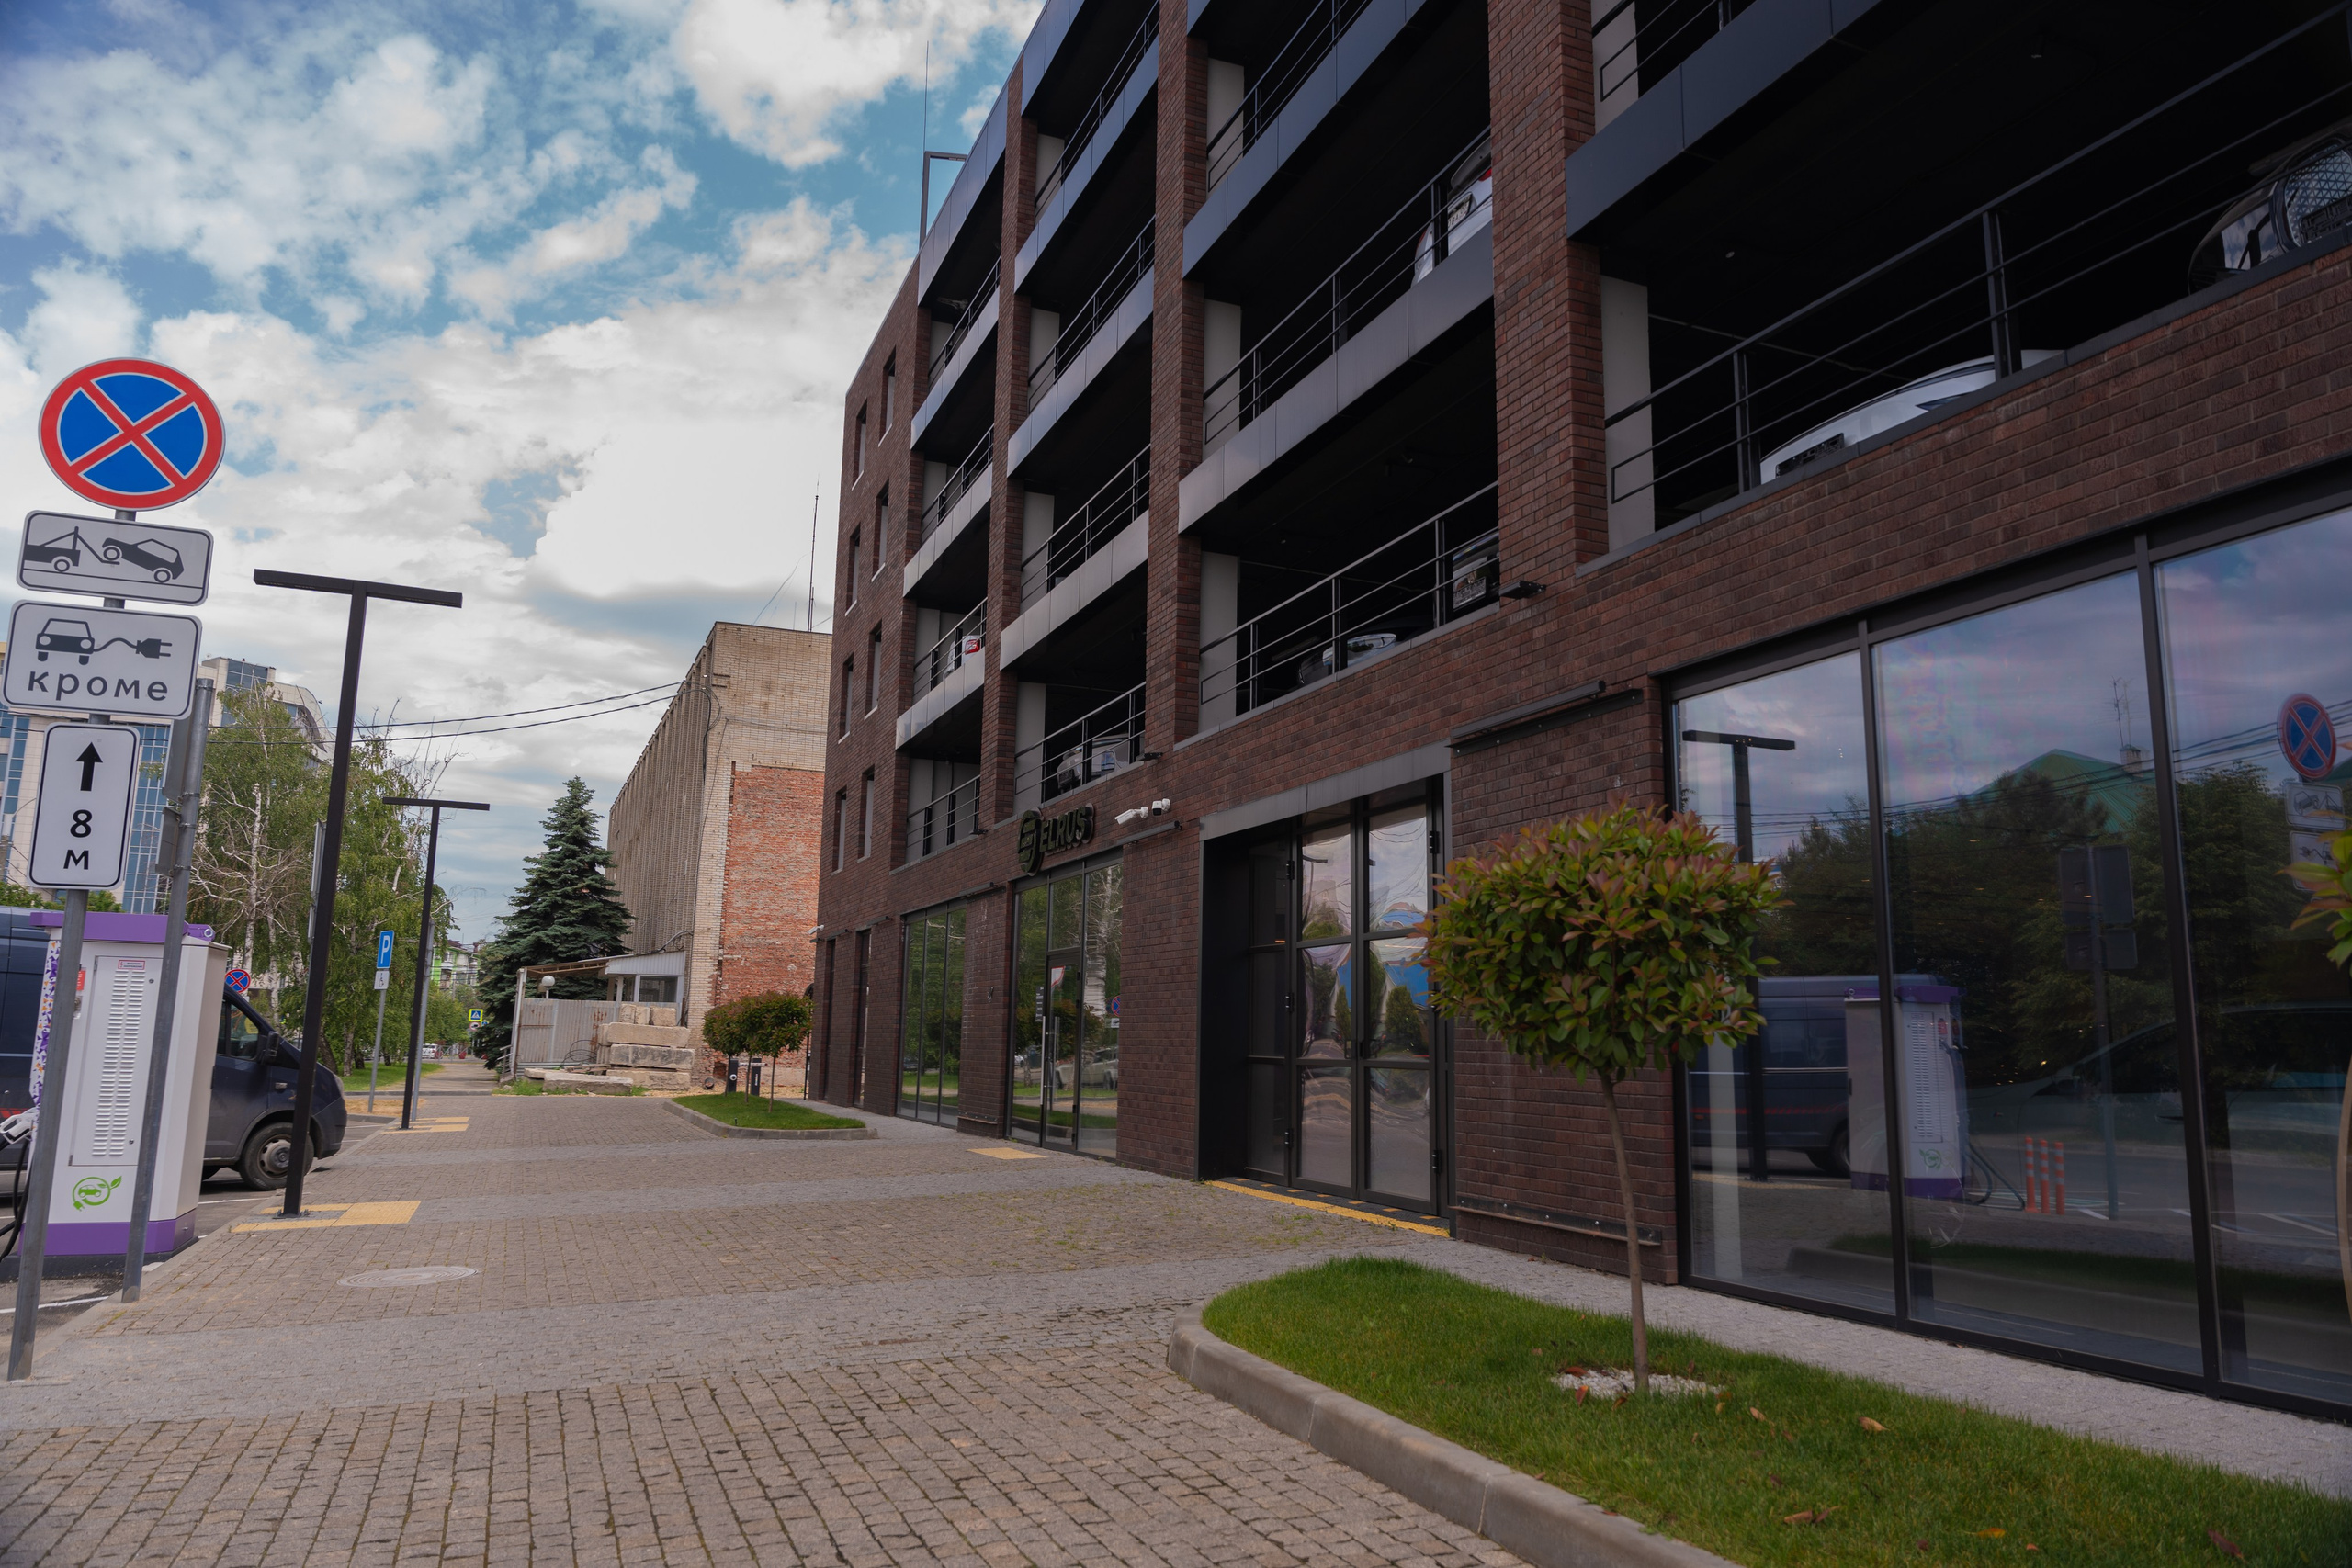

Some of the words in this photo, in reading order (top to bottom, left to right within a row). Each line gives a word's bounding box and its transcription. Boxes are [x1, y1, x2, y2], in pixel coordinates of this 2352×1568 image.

[28, 671, 168, 702] кроме
[70, 809, 93, 839] 8
[1039, 805, 1091, 852] ELRUS
